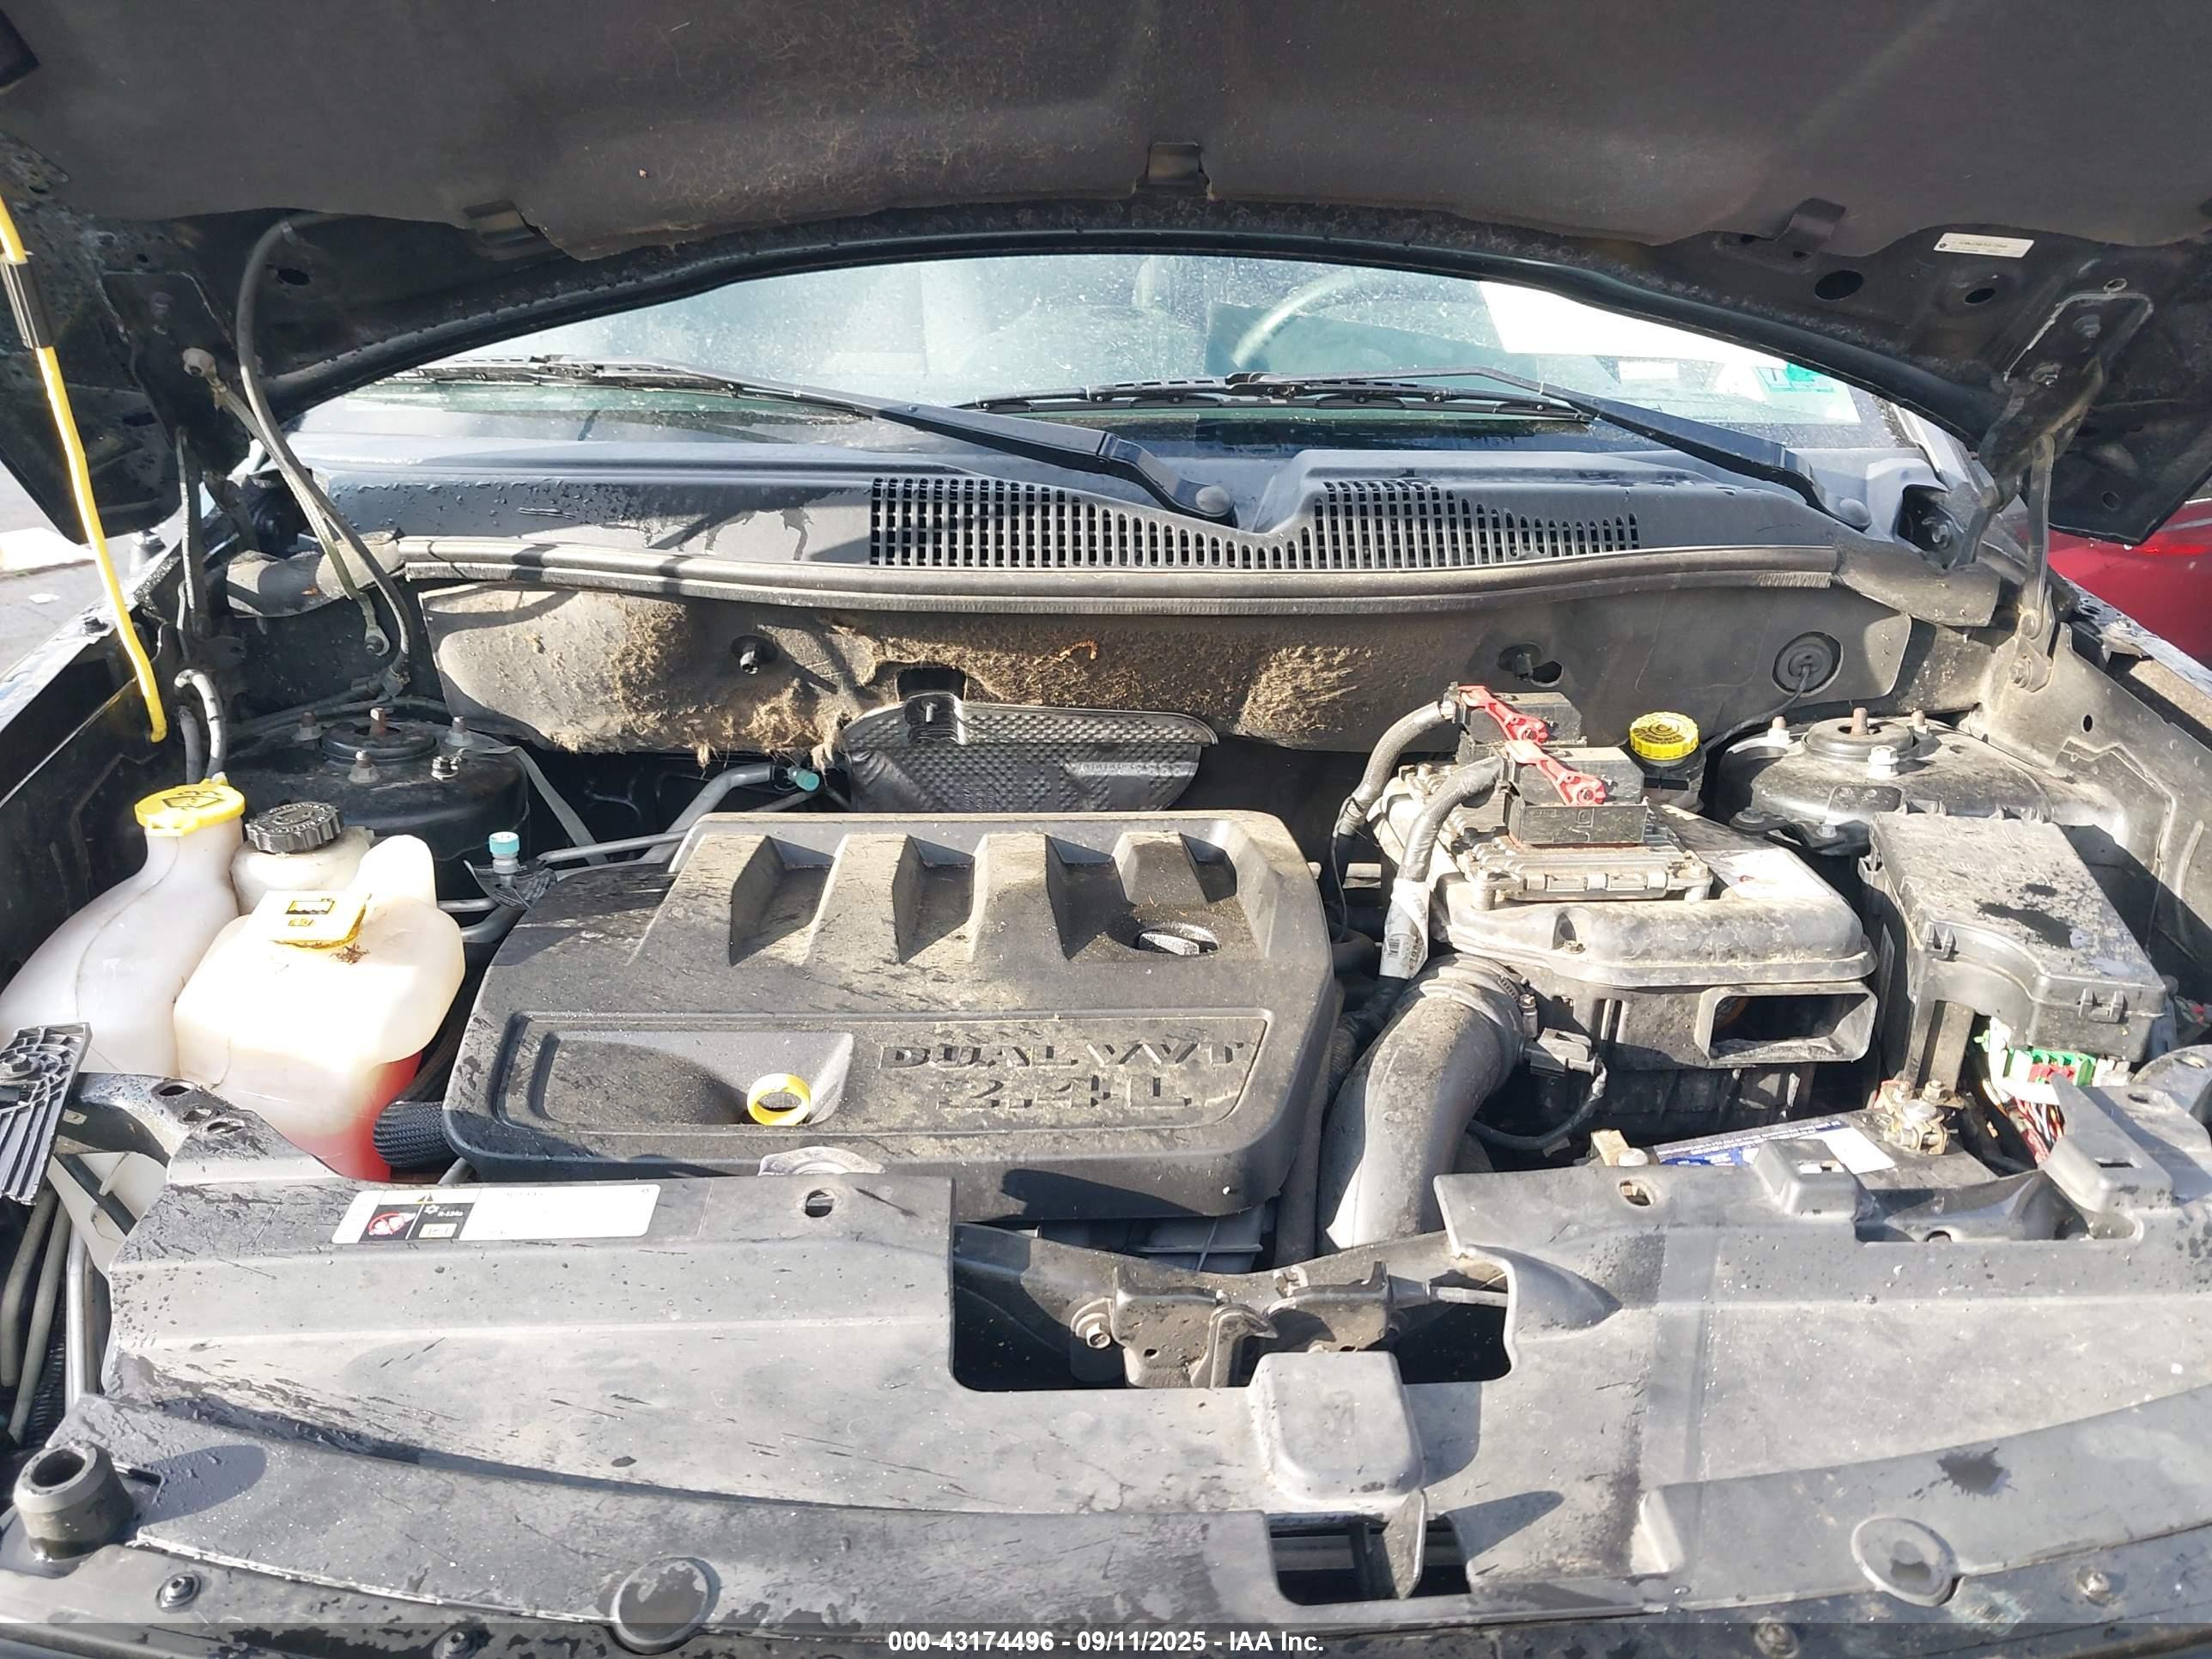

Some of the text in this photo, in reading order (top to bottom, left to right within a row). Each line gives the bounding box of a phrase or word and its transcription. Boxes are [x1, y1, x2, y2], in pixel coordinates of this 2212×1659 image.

[878, 1042, 1244, 1069] DUAL VVT
[937, 1075, 1192, 1109] 2.4L
